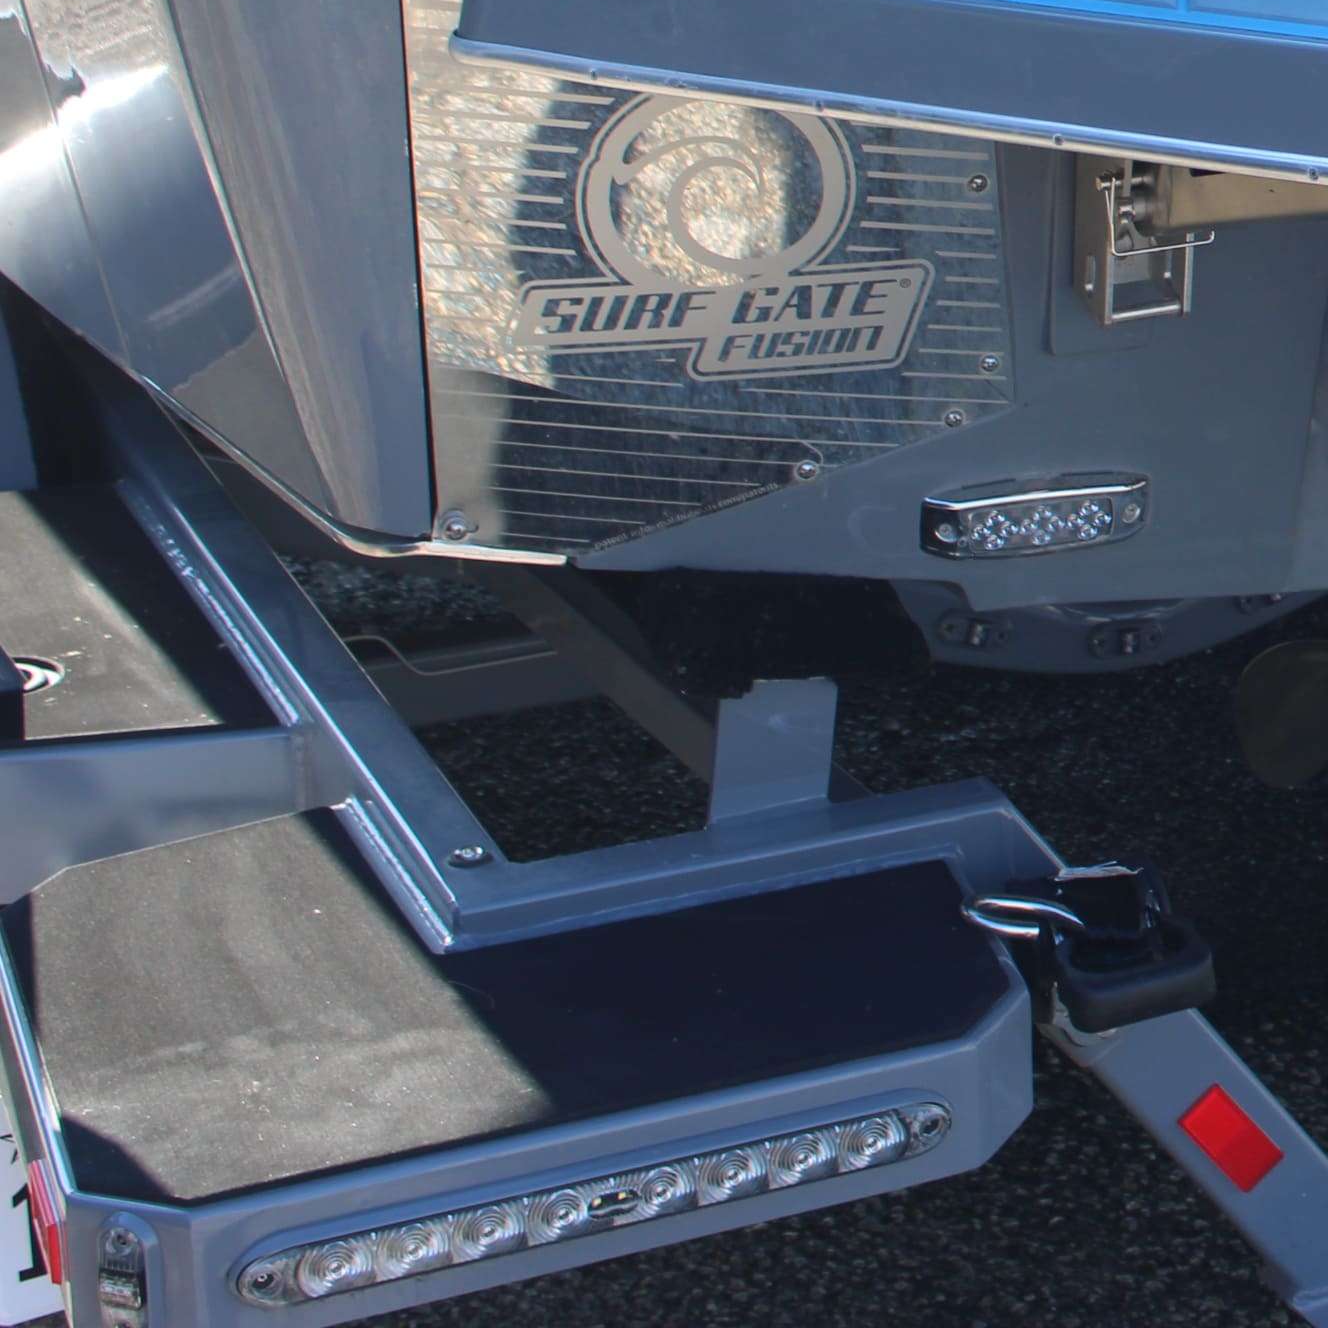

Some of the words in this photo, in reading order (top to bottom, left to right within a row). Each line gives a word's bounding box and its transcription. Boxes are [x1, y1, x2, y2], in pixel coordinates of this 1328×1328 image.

[541, 290, 716, 334] SURF
[731, 278, 898, 325] GATE
[717, 324, 884, 362] FUSION
